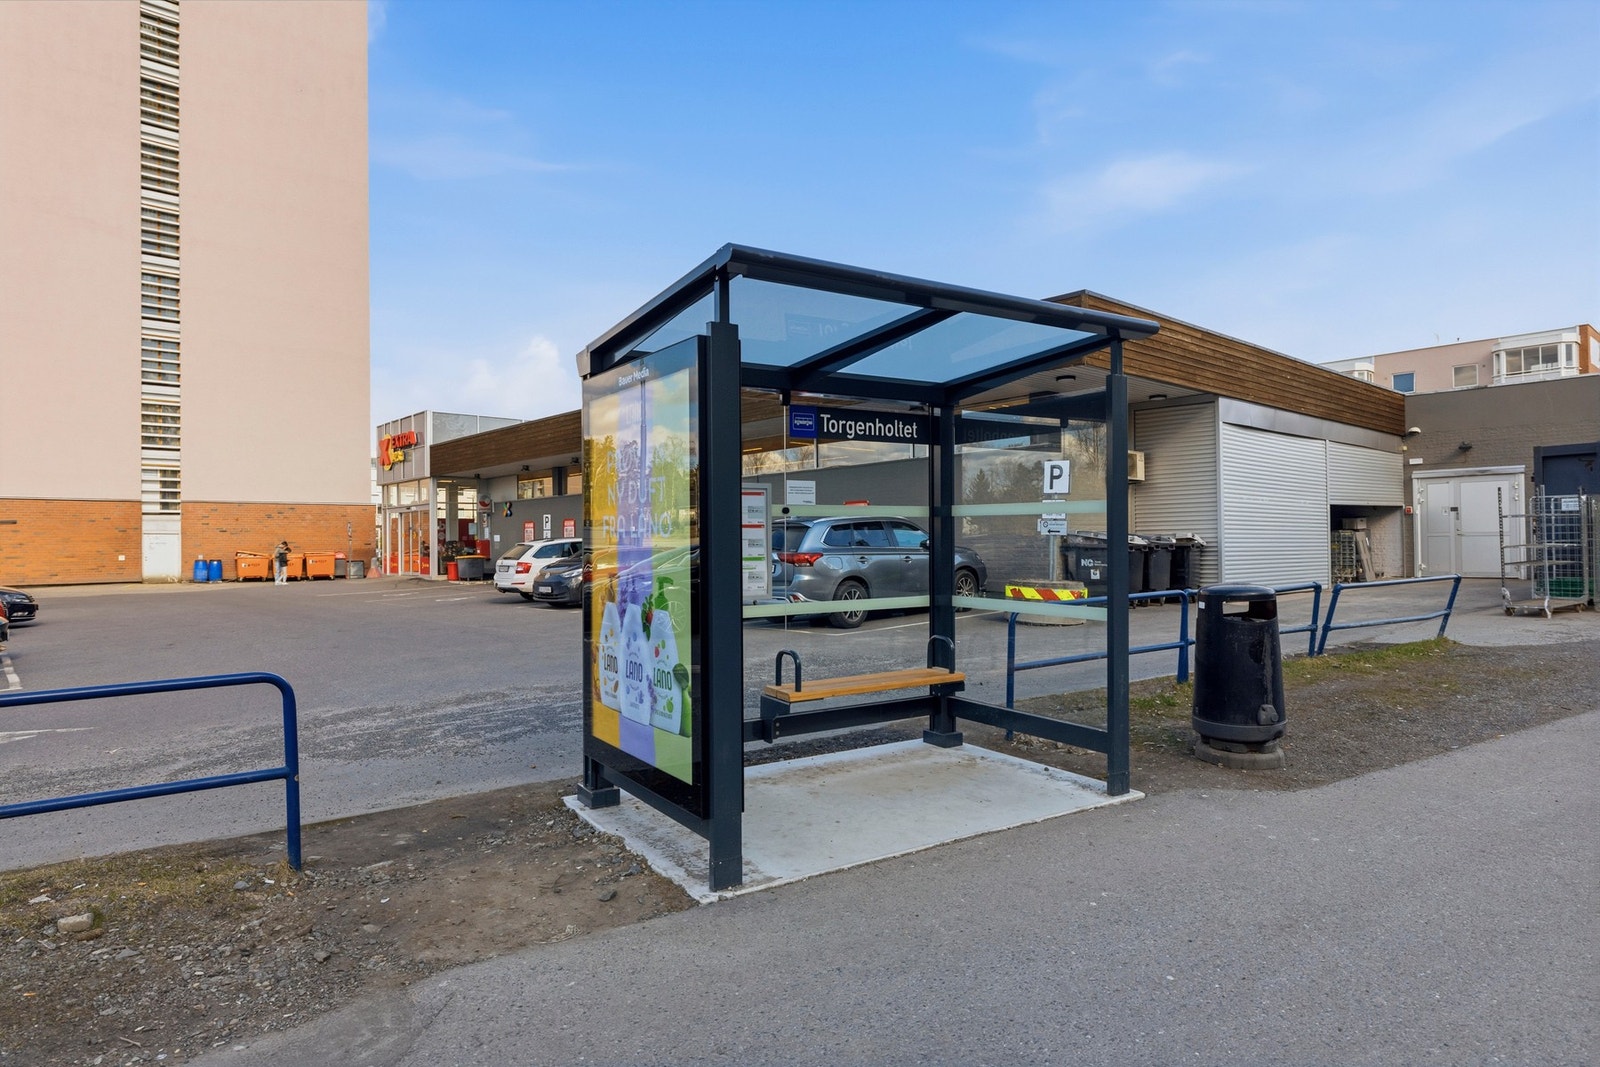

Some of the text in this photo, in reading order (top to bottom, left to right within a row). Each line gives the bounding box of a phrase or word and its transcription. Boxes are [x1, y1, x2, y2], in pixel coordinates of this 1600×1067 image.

[618, 366, 650, 386] Bauer Media
[820, 413, 918, 439] Torgenholtet
[1049, 464, 1064, 490] P
[607, 475, 666, 507] NY DUFT
[602, 513, 626, 539] FRA
[604, 653, 618, 674] LANO
[625, 659, 643, 683] LANO
[653, 667, 672, 691] LANO
